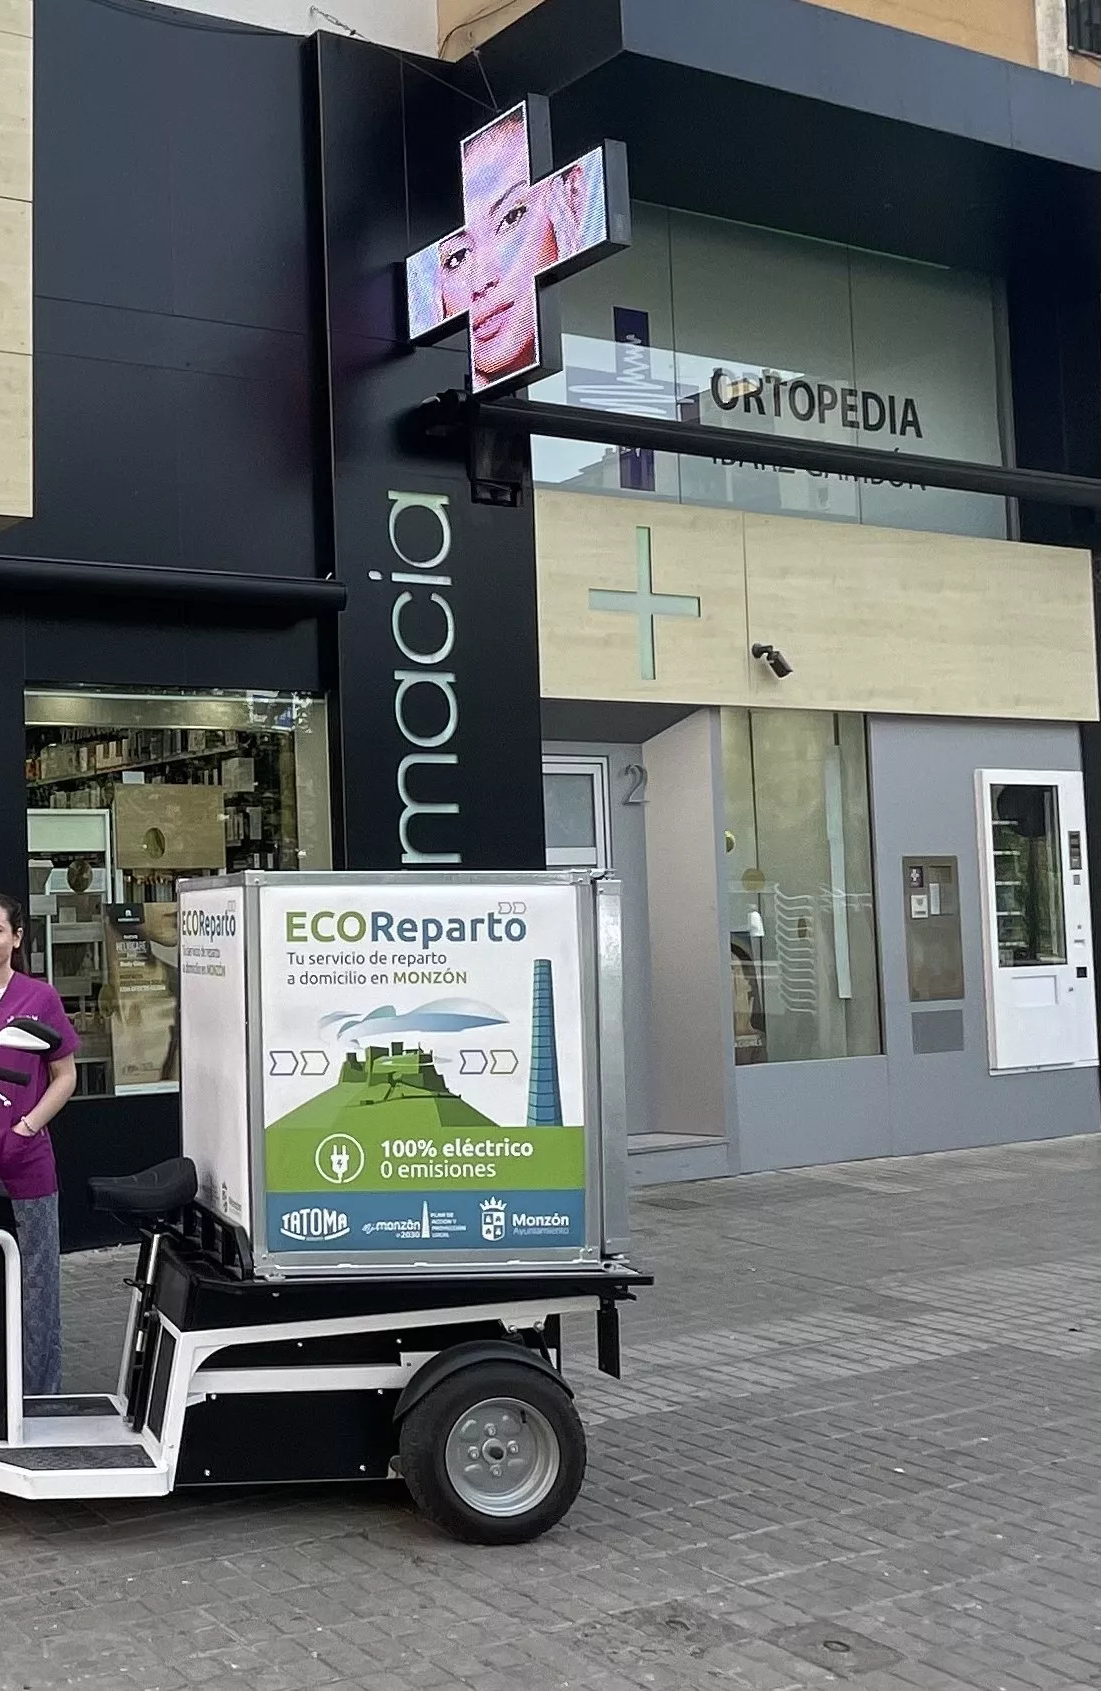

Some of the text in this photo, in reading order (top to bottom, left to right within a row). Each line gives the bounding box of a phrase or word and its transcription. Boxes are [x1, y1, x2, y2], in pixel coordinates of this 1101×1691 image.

[711, 367, 923, 438] ORTOPEDIA
[368, 490, 462, 864] macia
[622, 764, 649, 805] 2
[182, 909, 236, 943] ECOReparto
[286, 911, 527, 949] ECOReparto
[287, 951, 447, 967] Tu servicio de reparto
[287, 968, 467, 985] a domicilio en MONZÓN
[380, 1138, 534, 1158] 100% eléctrico
[380, 1160, 496, 1178] 0 emisiones
[281, 1208, 348, 1236] TATOMA
[512, 1212, 569, 1226] Monzón
[512, 1227, 570, 1236] Ayuntamiento
